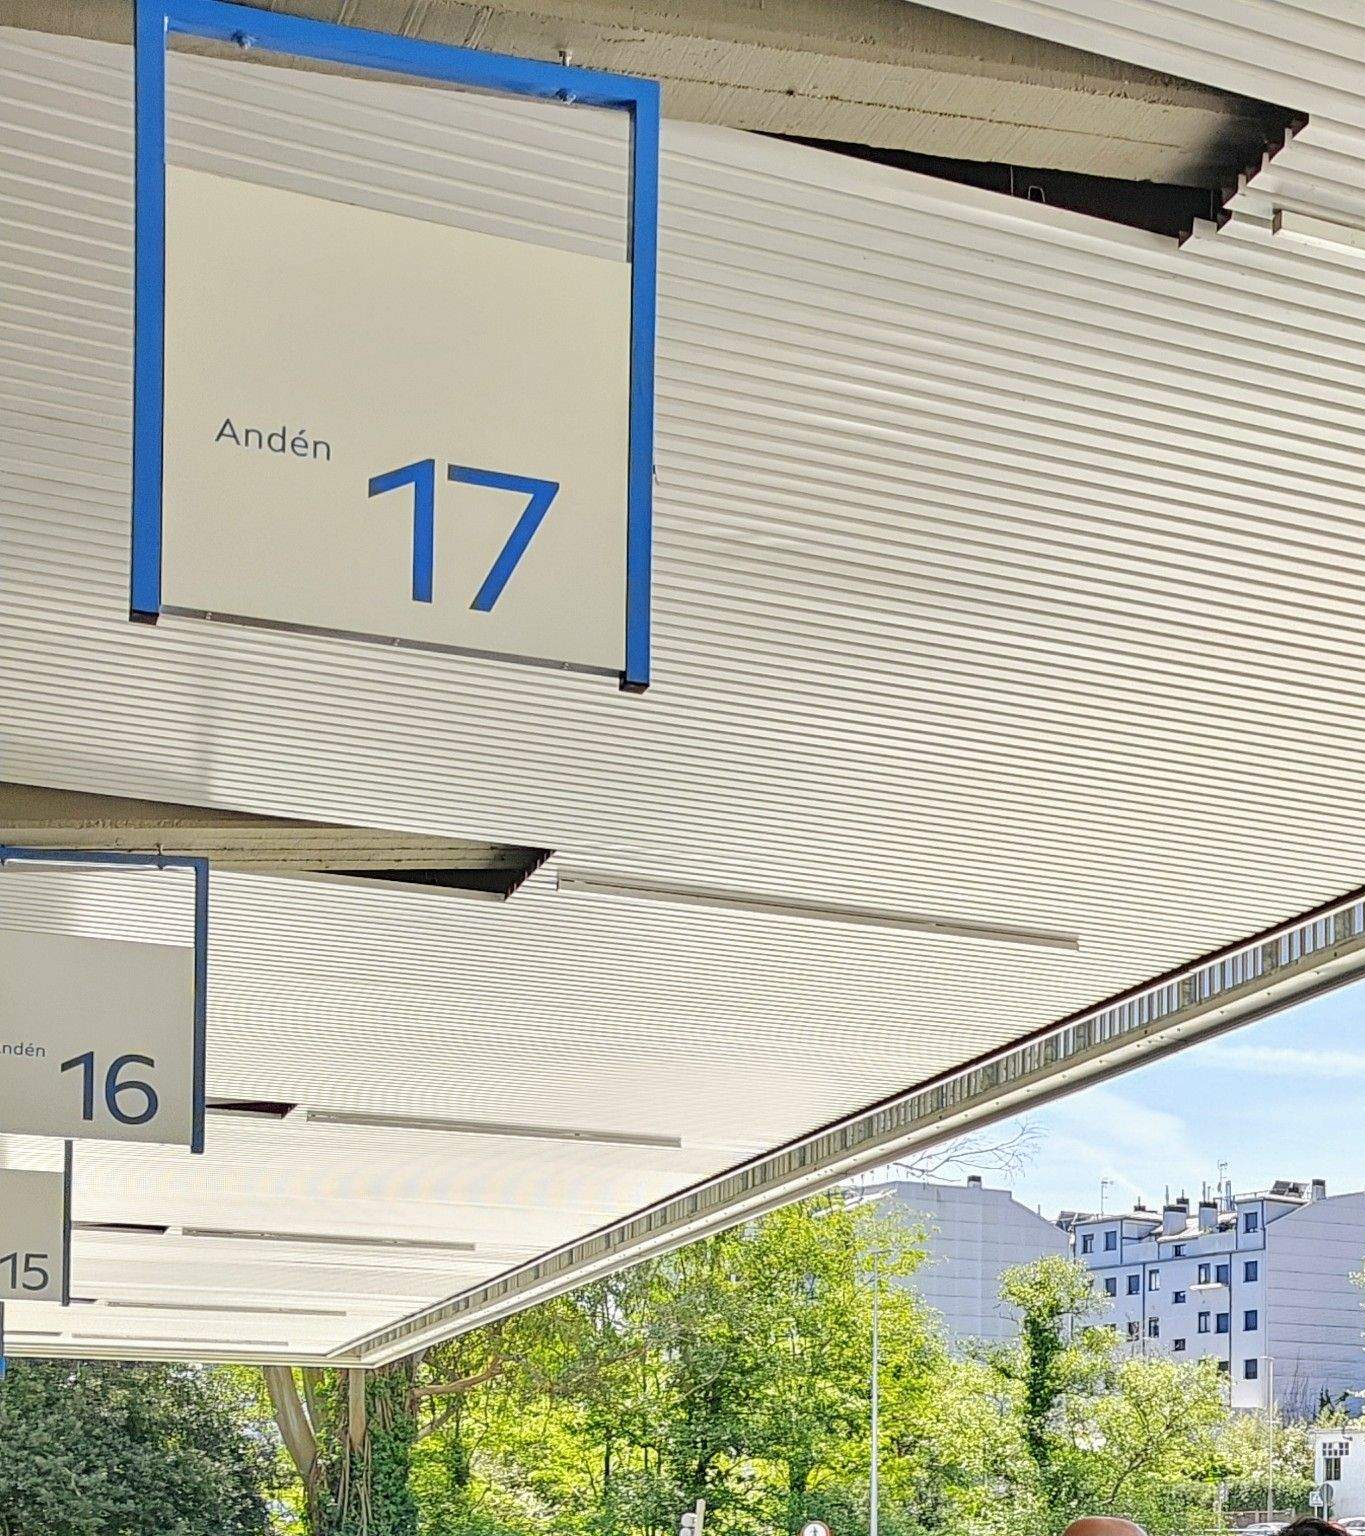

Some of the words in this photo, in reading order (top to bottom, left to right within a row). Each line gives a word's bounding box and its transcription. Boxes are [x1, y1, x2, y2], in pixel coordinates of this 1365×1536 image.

[214, 418, 332, 462] Andén
[367, 458, 560, 613] 17
[0, 1042, 46, 1058] ndén
[60, 1050, 159, 1125] 16
[0, 1251, 49, 1292] 15
